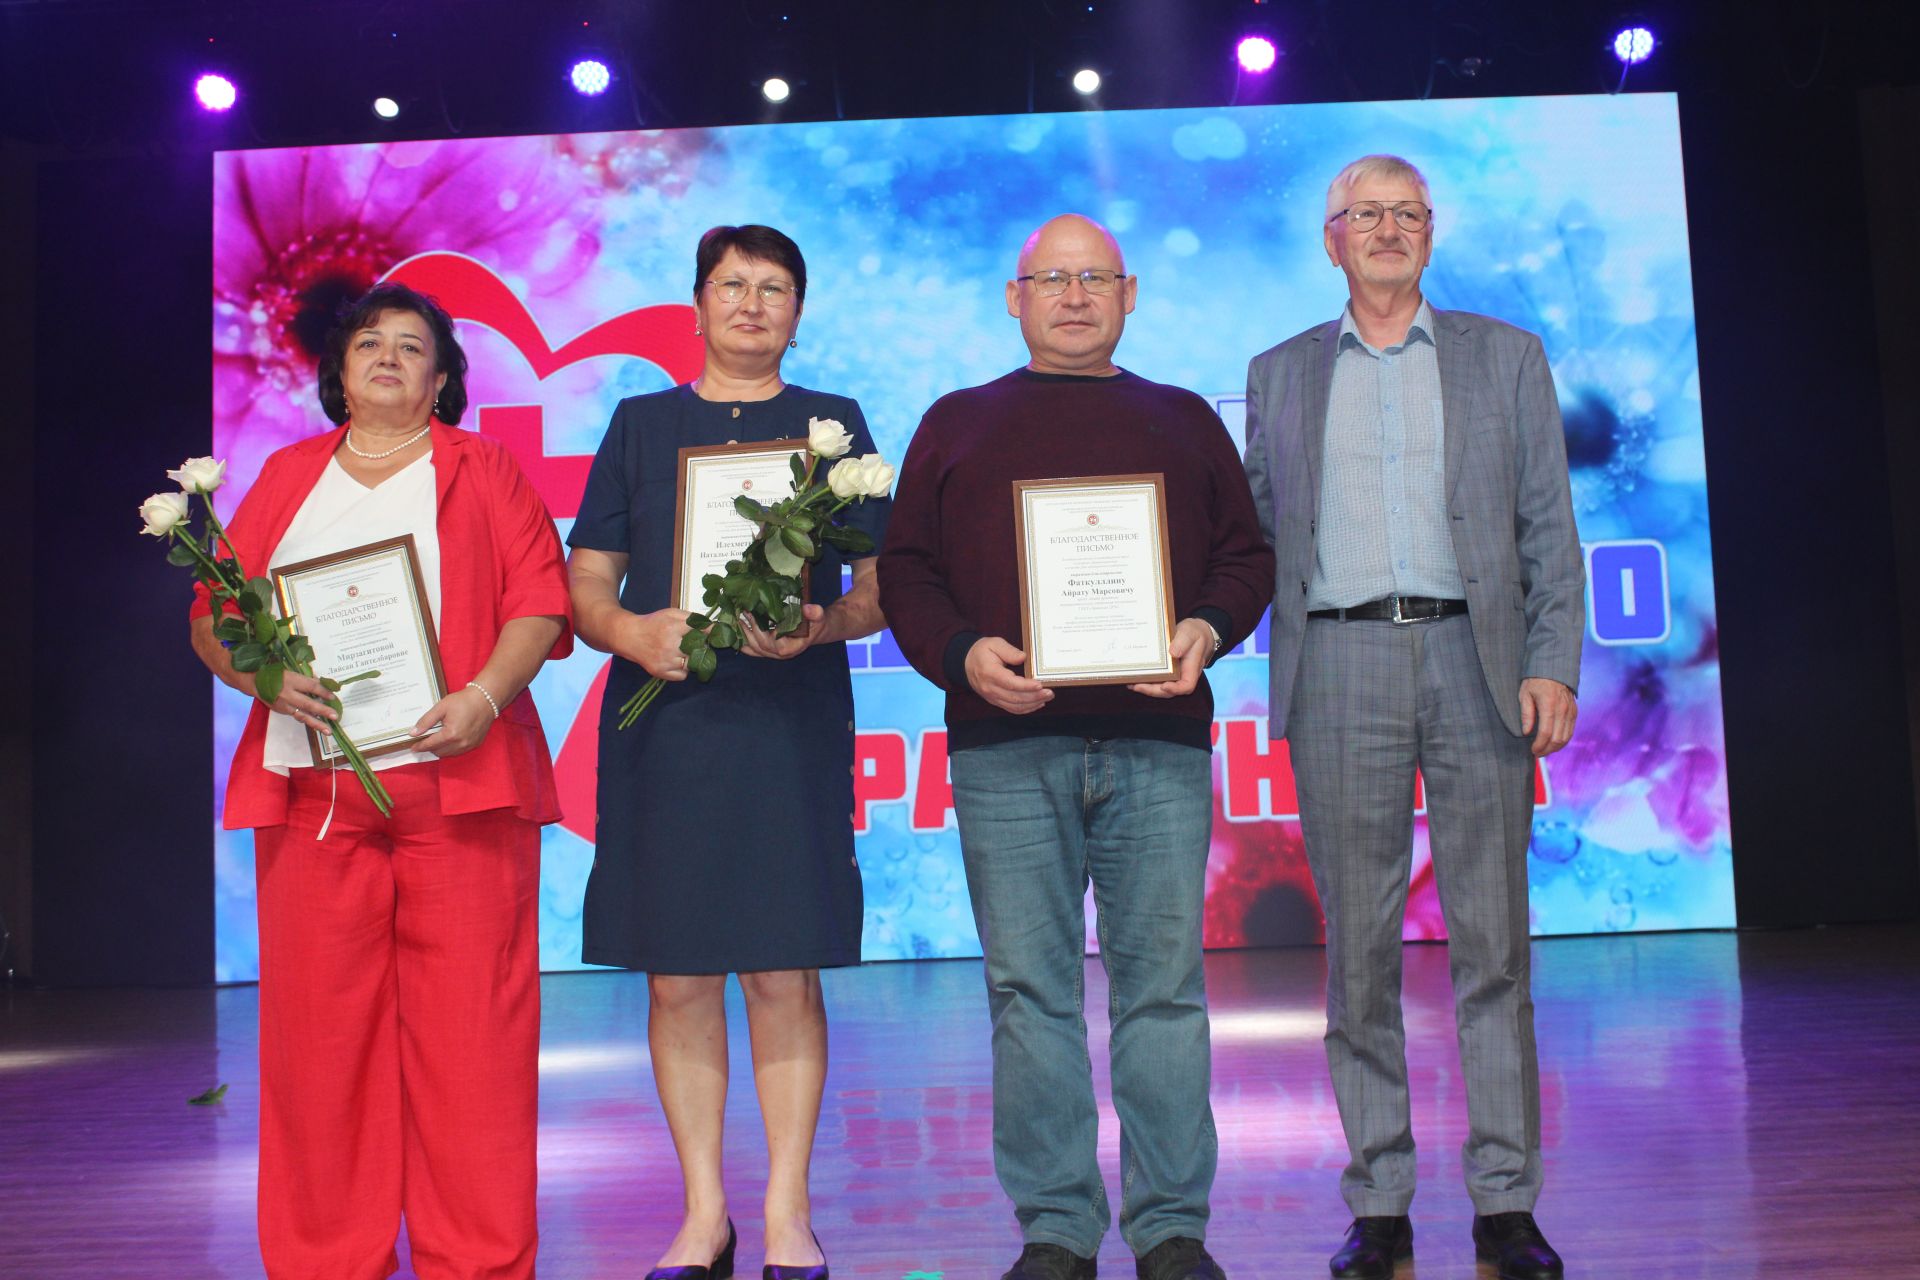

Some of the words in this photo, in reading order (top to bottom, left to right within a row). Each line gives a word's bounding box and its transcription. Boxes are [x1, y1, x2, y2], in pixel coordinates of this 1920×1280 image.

[1050, 533, 1138, 545] БЛАГОДАРСТВЕННОЕ
[1076, 543, 1114, 553] ПИСЬМО
[315, 596, 398, 623] БЛАГОДАРСТВЕННОЕ
[342, 612, 377, 627] ПИСЬМО
